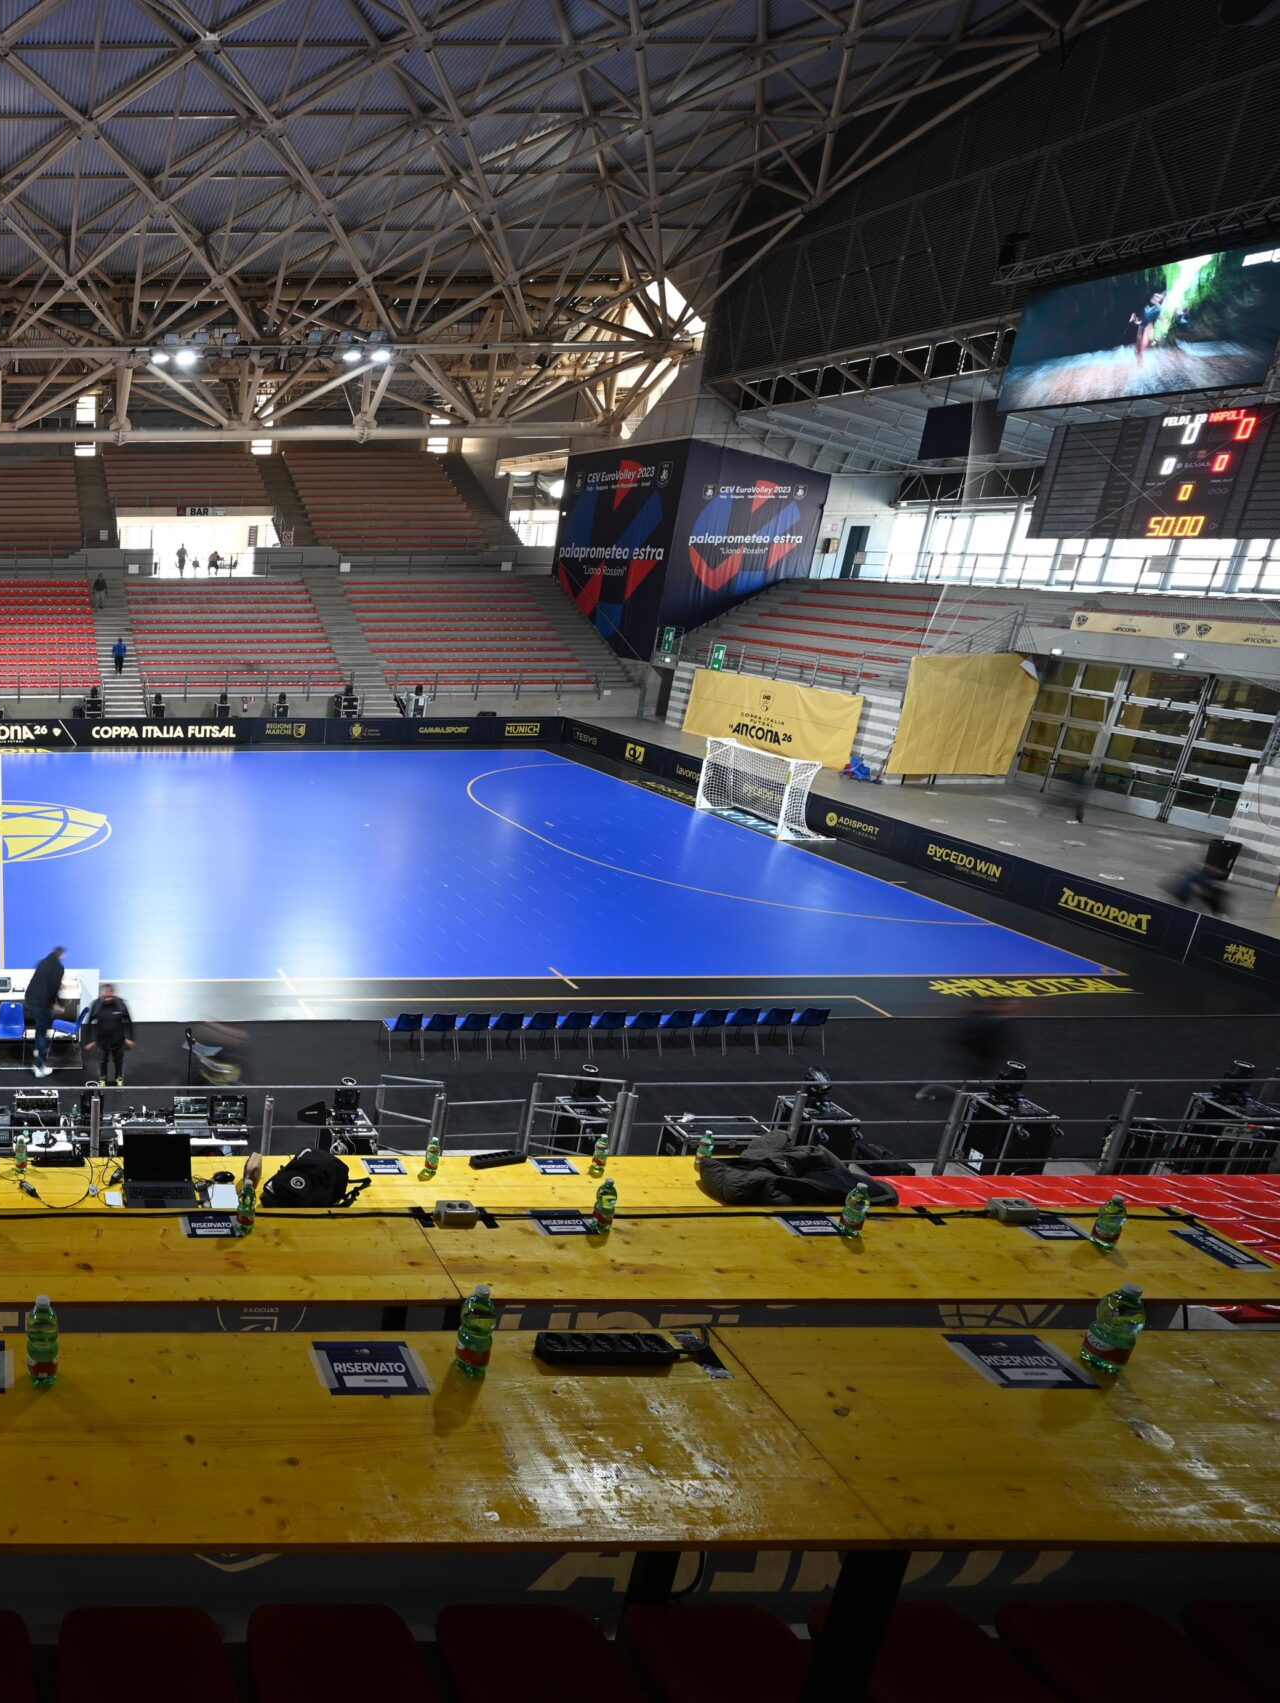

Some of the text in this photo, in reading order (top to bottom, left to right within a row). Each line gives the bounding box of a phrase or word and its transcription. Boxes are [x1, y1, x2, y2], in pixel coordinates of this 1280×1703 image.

[1208, 409, 1246, 423] NAPOLI
[1181, 417, 1257, 445] 0 0
[1160, 454, 1230, 475] 0 0
[586, 472, 601, 484] CEV
[601, 468, 637, 482] EuroVolley
[637, 465, 656, 478] 2023
[719, 485, 736, 494] CEV
[736, 485, 773, 495] EuroVolley
[1177, 483, 1193, 501] 0
[190, 508, 209, 516] BAR
[688, 532, 804, 547] palaprometeo estra
[559, 541, 665, 562] palaprometeo estra
[33, 725, 48, 735] 26
[505, 724, 540, 735] MUNICH
[763, 717, 785, 727] ITALIA
[91, 725, 237, 739] COPPA ITALIA FUTSAL
[575, 731, 598, 746] TESYS
[731, 722, 793, 746] ANCONA 26
[676, 764, 701, 783] Lavorop
[715, 810, 778, 834] KINT
[837, 816, 880, 836] ADISPORT
[976, 859, 1003, 879] WIN
[1059, 886, 1153, 932] TUTTOSPORT
[332, 1362, 406, 1374] RISERVATO
[980, 1355, 1058, 1367] RISERVATO
